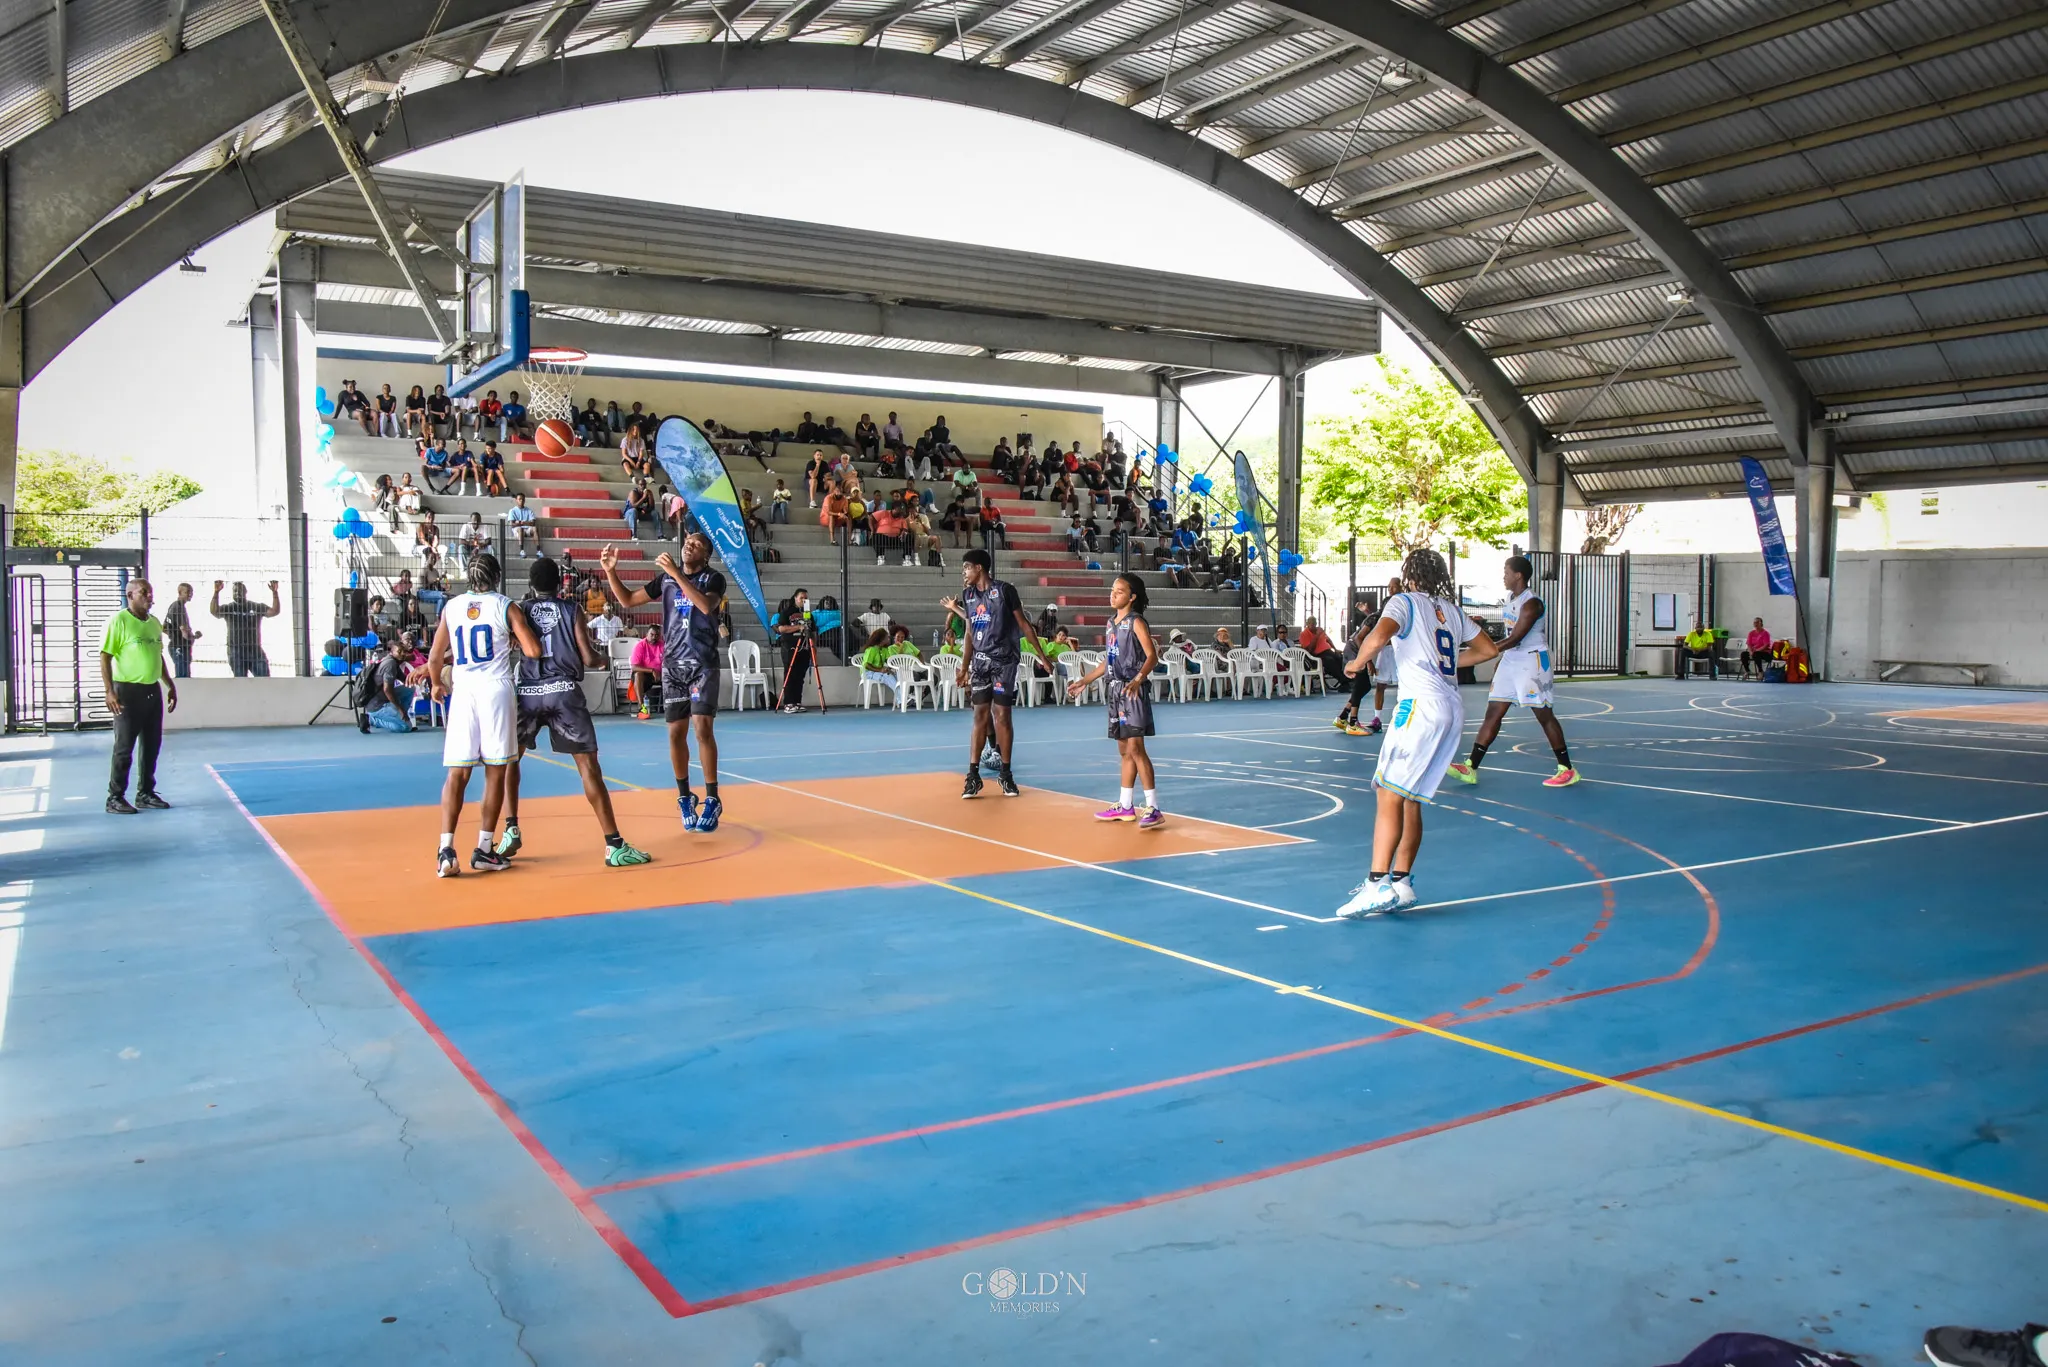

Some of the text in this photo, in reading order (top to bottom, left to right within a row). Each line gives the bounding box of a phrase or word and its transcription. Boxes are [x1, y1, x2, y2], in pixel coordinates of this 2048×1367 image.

[455, 624, 494, 665] 10
[977, 631, 983, 641] 8
[1435, 628, 1456, 676] 9
